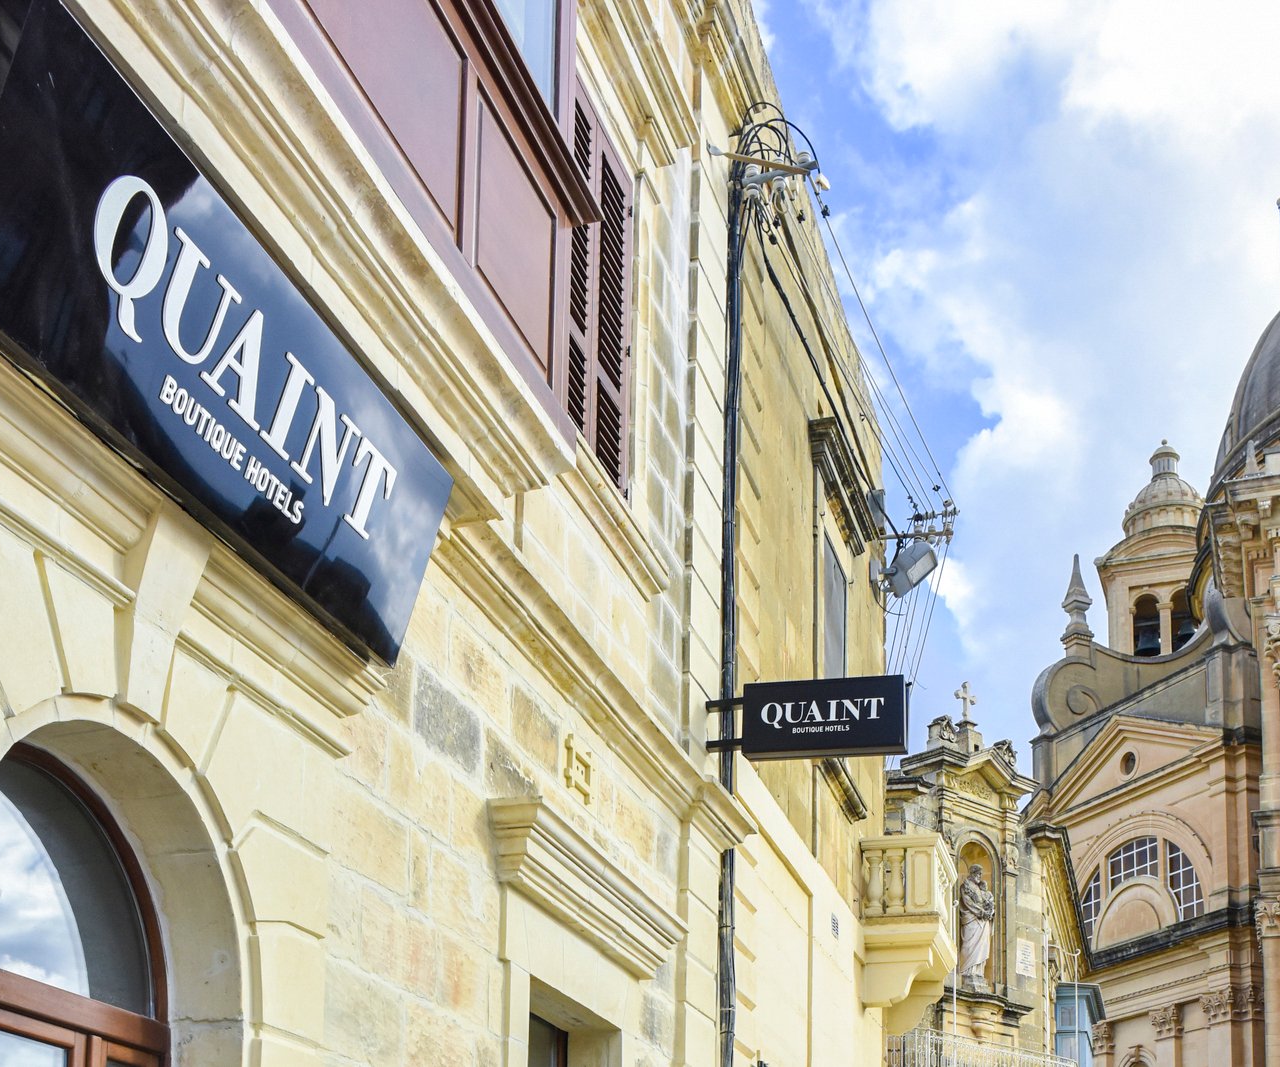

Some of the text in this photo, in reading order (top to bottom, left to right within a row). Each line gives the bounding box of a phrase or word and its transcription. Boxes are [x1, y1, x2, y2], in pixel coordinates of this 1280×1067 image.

[93, 174, 398, 540] QUAINT
[160, 374, 305, 525] BOUTIQUE HOTELS
[760, 697, 885, 729] QUAINT
[792, 724, 850, 734] BOUTIQUE HOTELS
